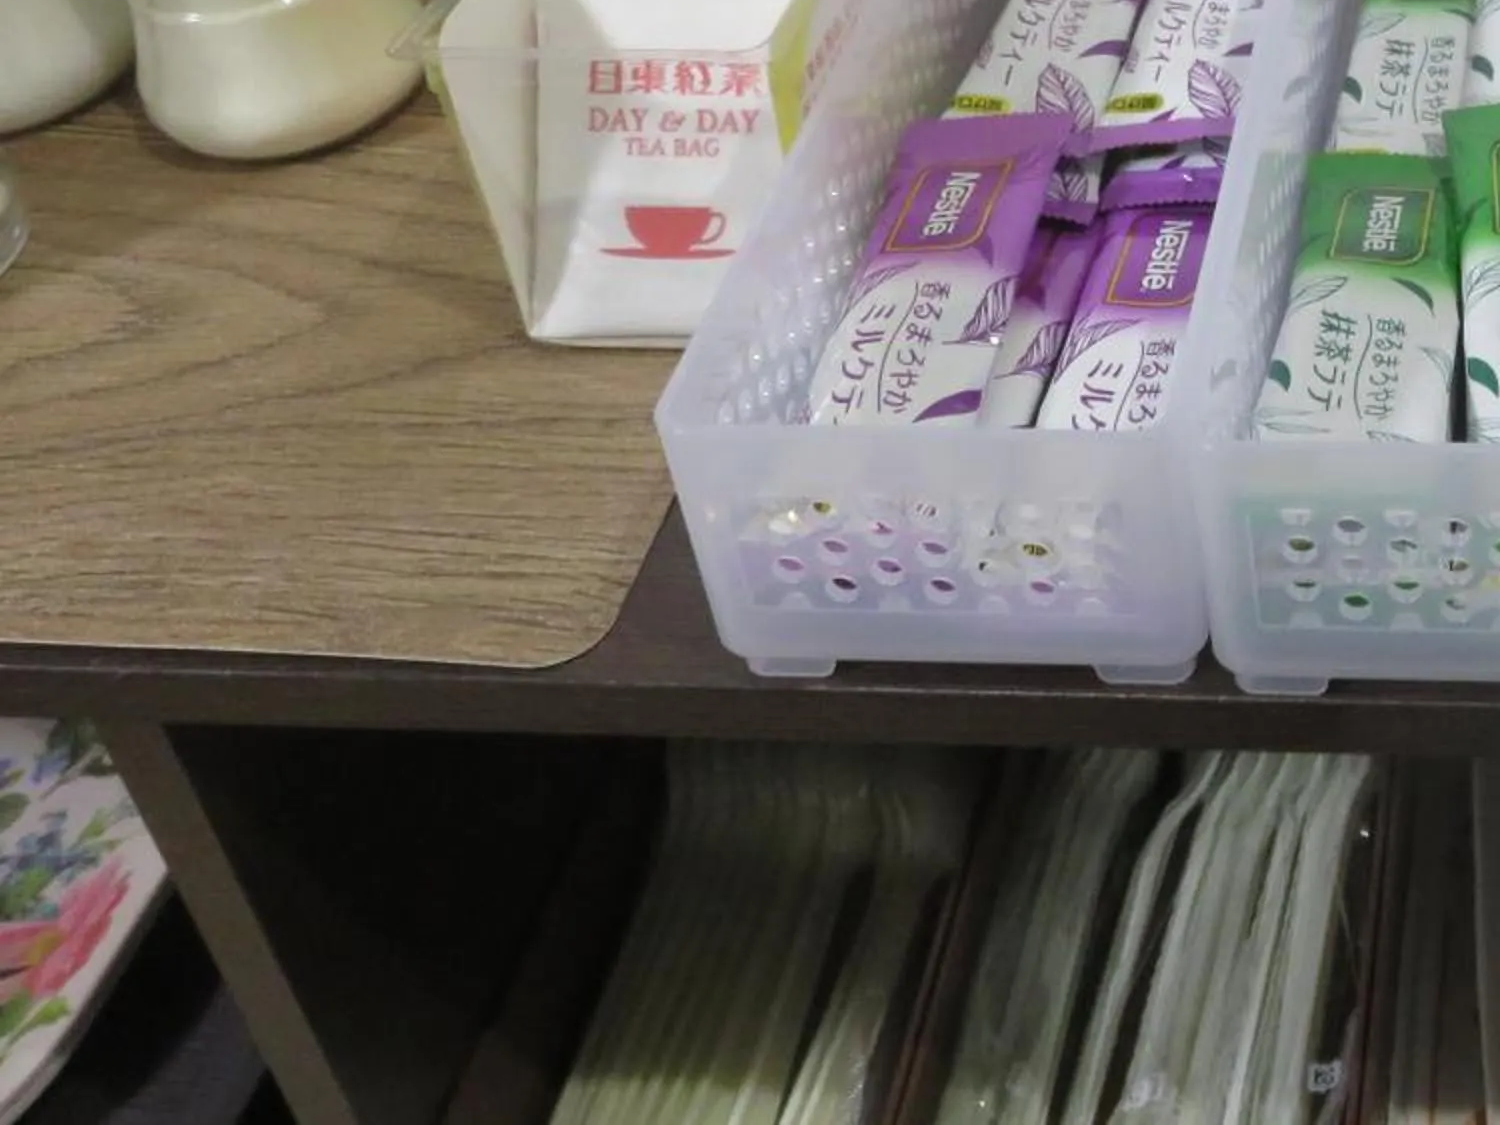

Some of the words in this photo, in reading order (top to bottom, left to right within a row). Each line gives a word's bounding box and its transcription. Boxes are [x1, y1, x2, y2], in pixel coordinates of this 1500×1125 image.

[587, 58, 764, 98] 日東紅茶
[588, 107, 649, 133] DAY
[656, 109, 687, 133] &
[695, 108, 761, 134] DAY
[624, 138, 666, 157] TEA
[673, 138, 720, 157] BAG
[831, 304, 897, 426] ミルクテ
[882, 282, 951, 414] 香るまろやか
[1128, 338, 1177, 432] 香るまろ
[1306, 308, 1359, 413] 抹茶ラテ
